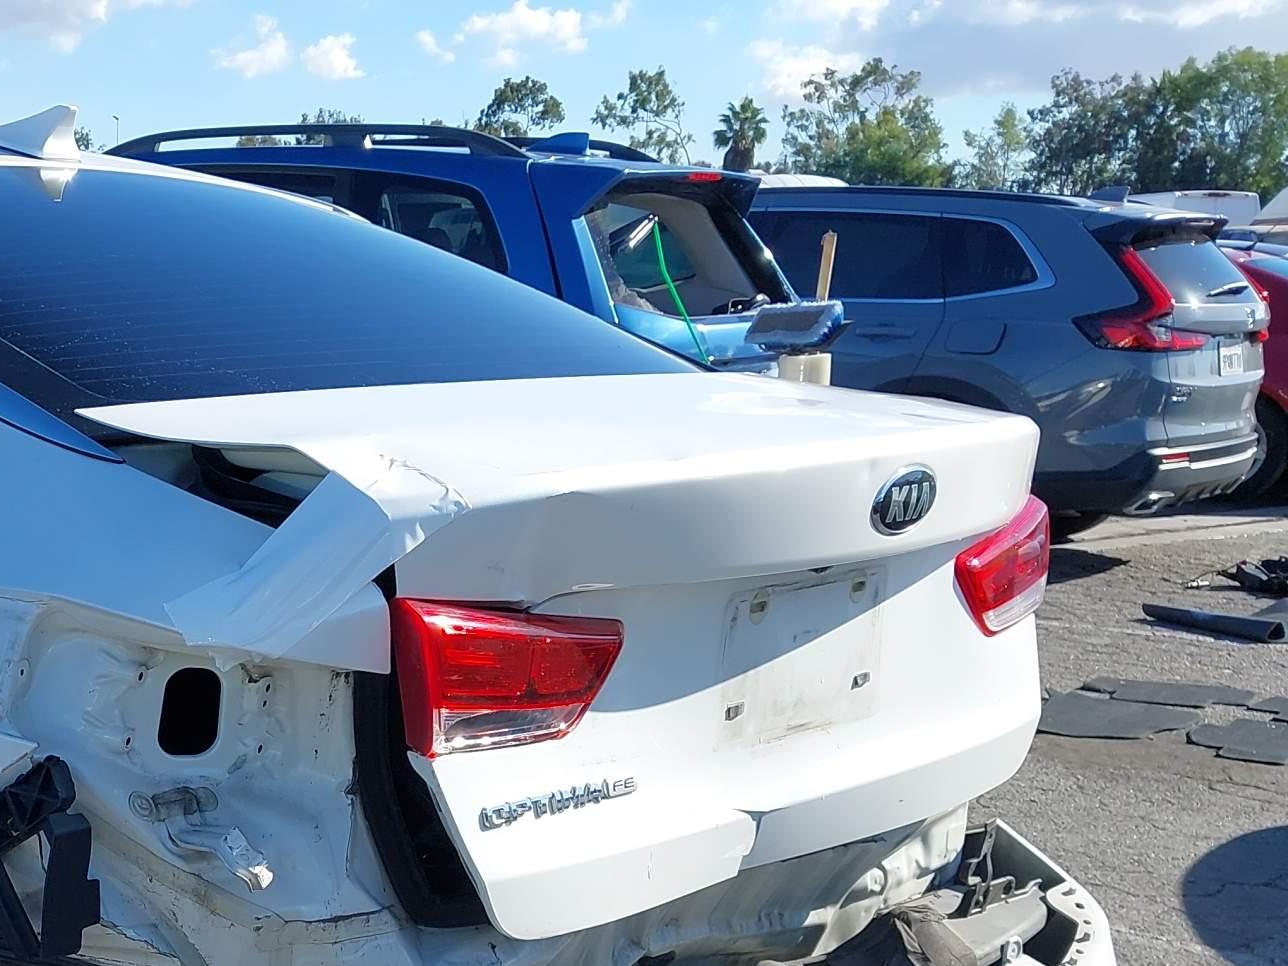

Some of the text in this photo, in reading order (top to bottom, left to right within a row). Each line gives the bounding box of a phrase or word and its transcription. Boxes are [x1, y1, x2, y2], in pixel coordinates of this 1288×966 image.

[885, 482, 930, 523] KIA
[478, 777, 635, 832] OPTIMA FE
